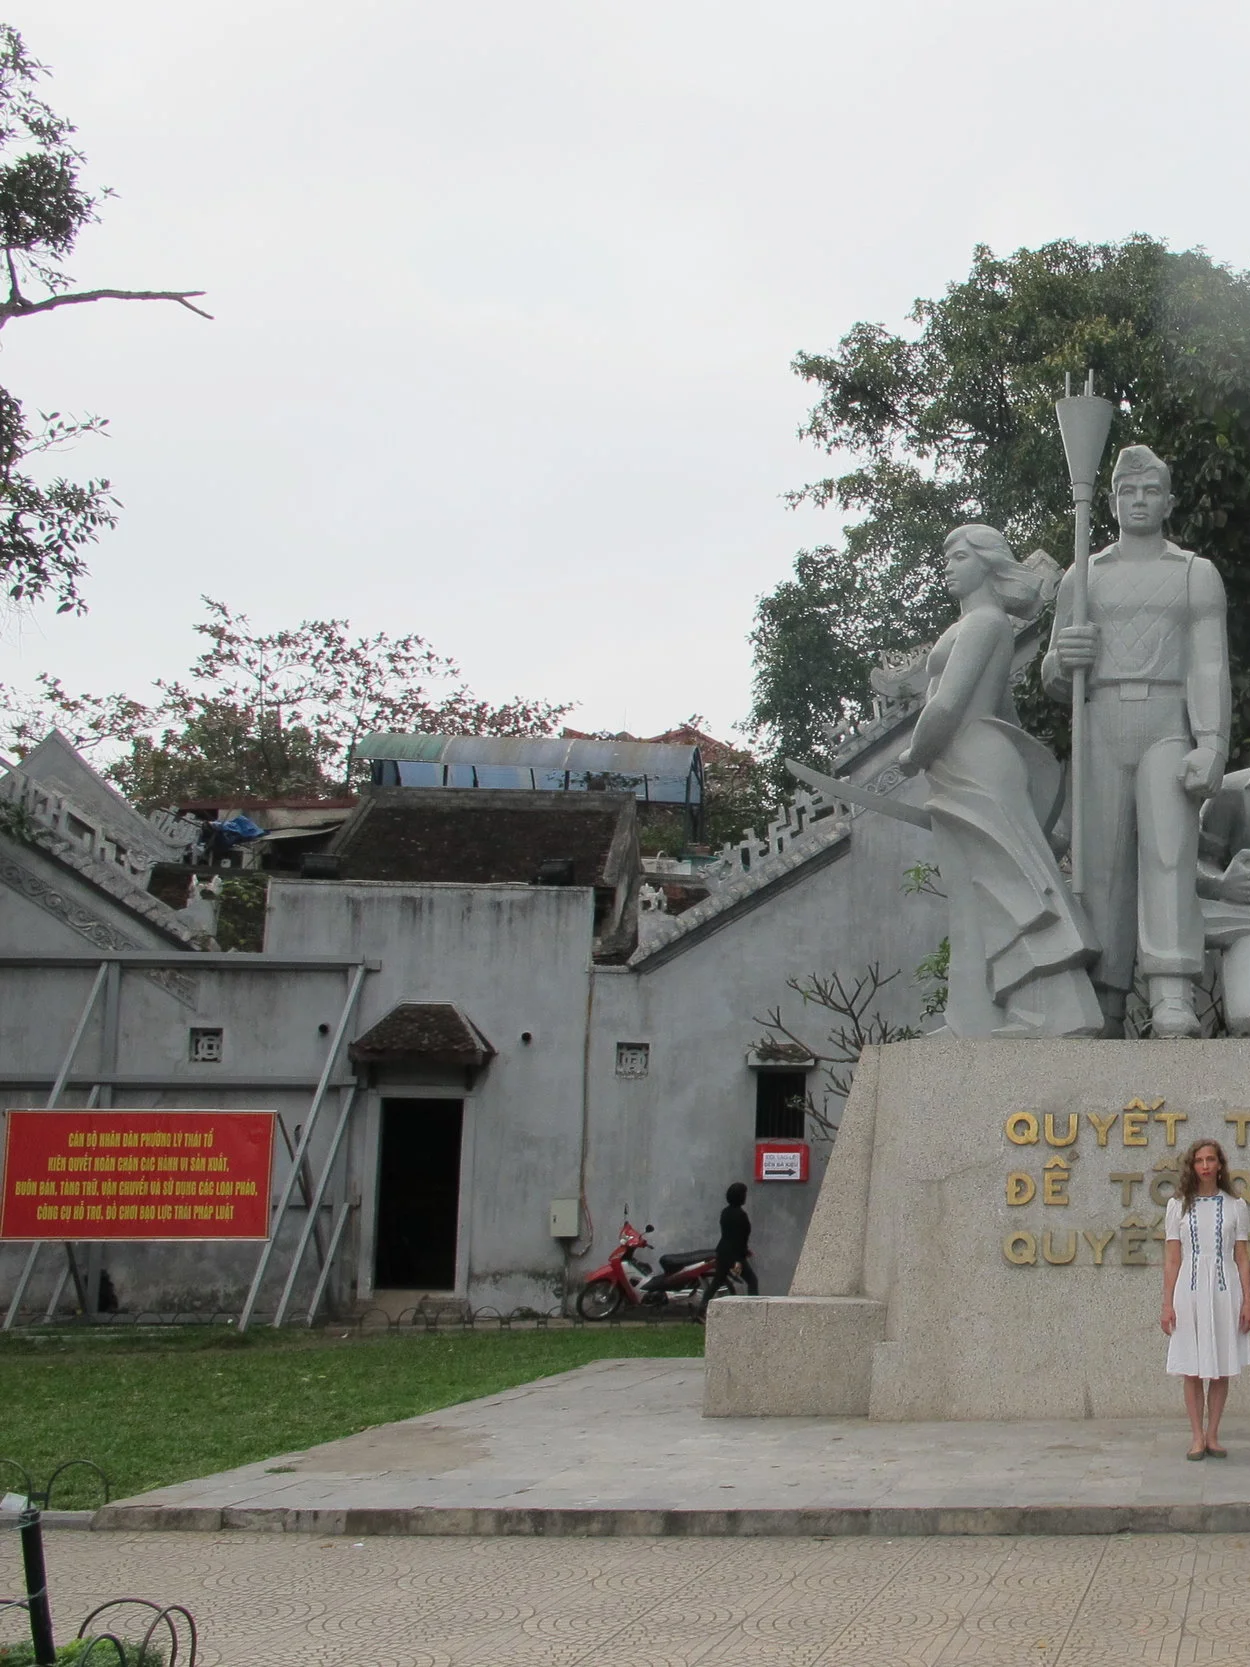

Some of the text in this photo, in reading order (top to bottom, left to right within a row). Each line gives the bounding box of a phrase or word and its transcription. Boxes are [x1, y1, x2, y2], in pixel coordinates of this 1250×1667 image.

[1004, 1096, 1188, 1147] QUYẾT
[99, 1130, 121, 1147] NHÂN
[122, 1130, 138, 1147] DÂN
[140, 1130, 171, 1147] PHƯỜNG
[173, 1130, 183, 1147] LÝ
[184, 1130, 202, 1147] THÁI
[48, 1154, 67, 1171] KIÊN
[68, 1152, 92, 1171] QUYẾT
[94, 1154, 116, 1171] NGĂN
[140, 1154, 156, 1171] CÁC
[157, 1154, 178, 1171] HÀNH
[180, 1157, 188, 1171] VI
[190, 1153, 206, 1171] SẢN
[15, 1178, 38, 1195] BUÔN
[119, 1175, 148, 1195] CHUYỂN
[150, 1178, 160, 1195] VÀ
[163, 1177, 174, 1195] SỬ
[175, 1181, 197, 1199] DỤNG
[199, 1178, 215, 1195] CÁC
[216, 1181, 233, 1199] LOẠI
[37, 1202, 58, 1219] CÔNG
[60, 1206, 71, 1222] CỤ
[73, 1200, 85, 1219] HỖ
[139, 1205, 156, 1223] BẠO
[158, 1205, 172, 1223] LỰC
[175, 1202, 192, 1219] TRÁI
[193, 1202, 214, 1219] PHÁP
[216, 1202, 234, 1223] LUẬT
